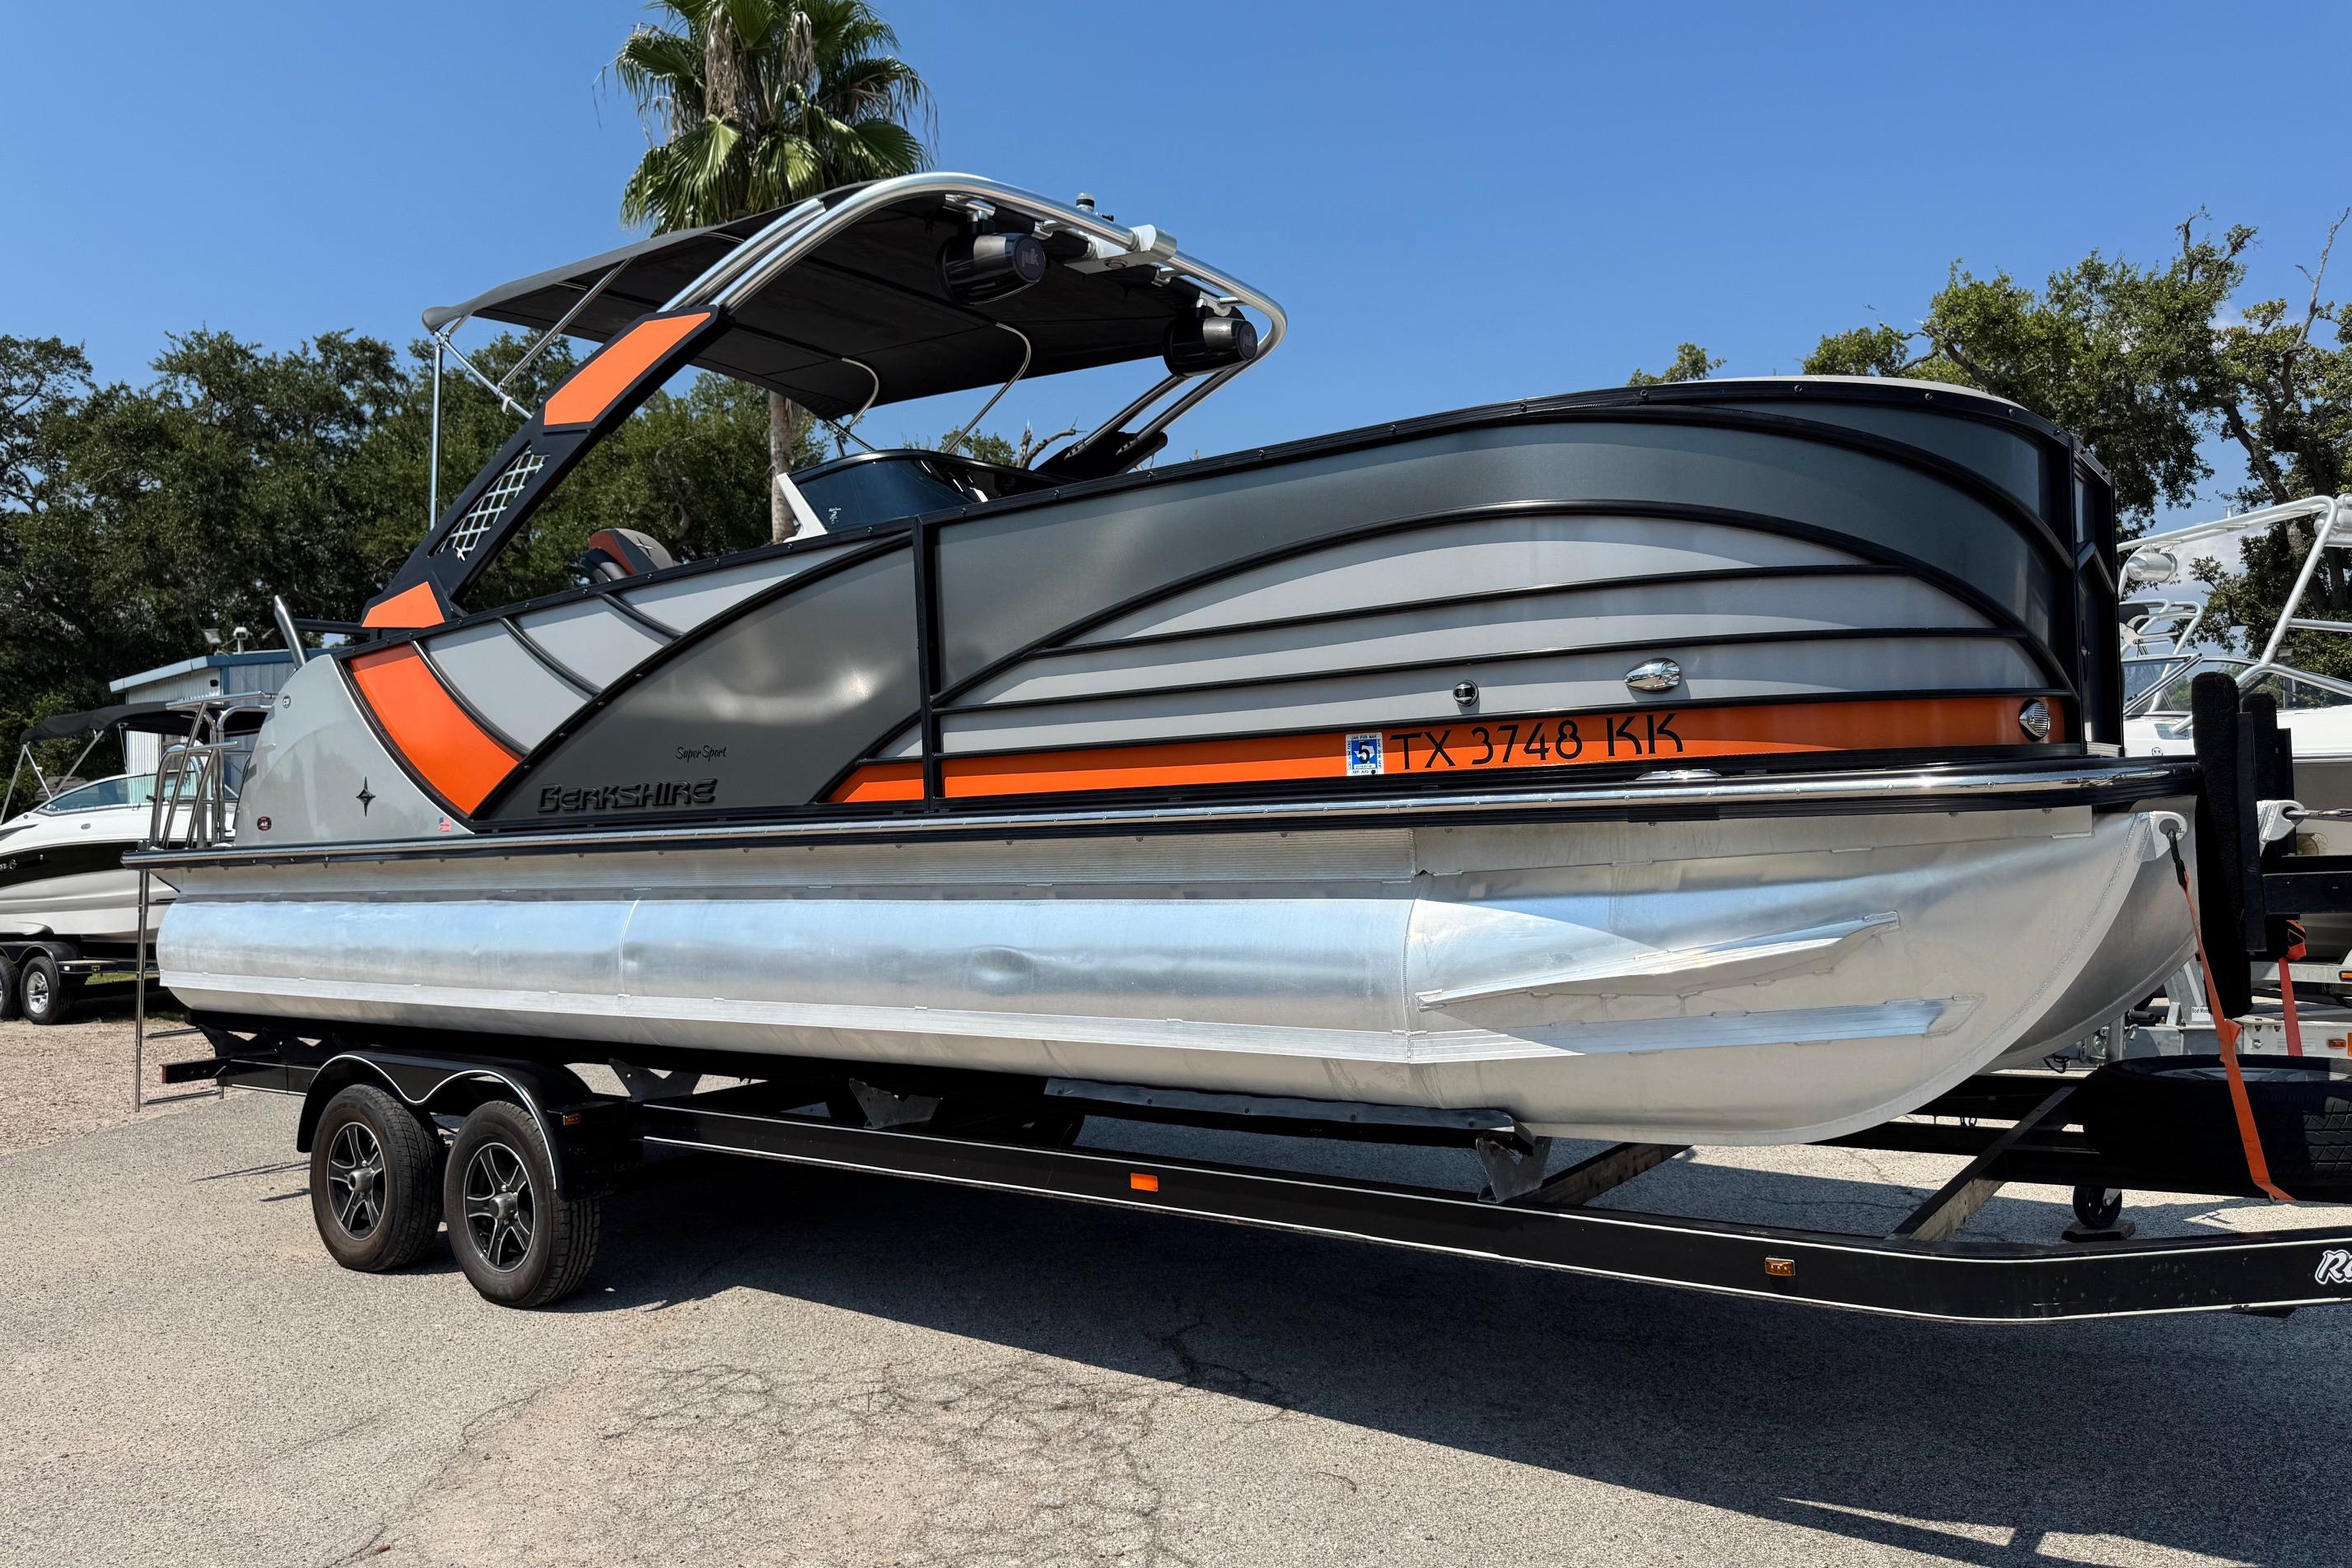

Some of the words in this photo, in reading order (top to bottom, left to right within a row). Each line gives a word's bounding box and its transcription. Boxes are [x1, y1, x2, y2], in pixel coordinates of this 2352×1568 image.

[675, 746, 702, 763] Super
[702, 744, 726, 762] Sport
[1358, 741, 1370, 764] 5
[1389, 730, 1456, 769] TX
[1472, 721, 1583, 765] 3748
[1606, 713, 1683, 756] KK
[537, 778, 718, 813] BERKSHIRE
